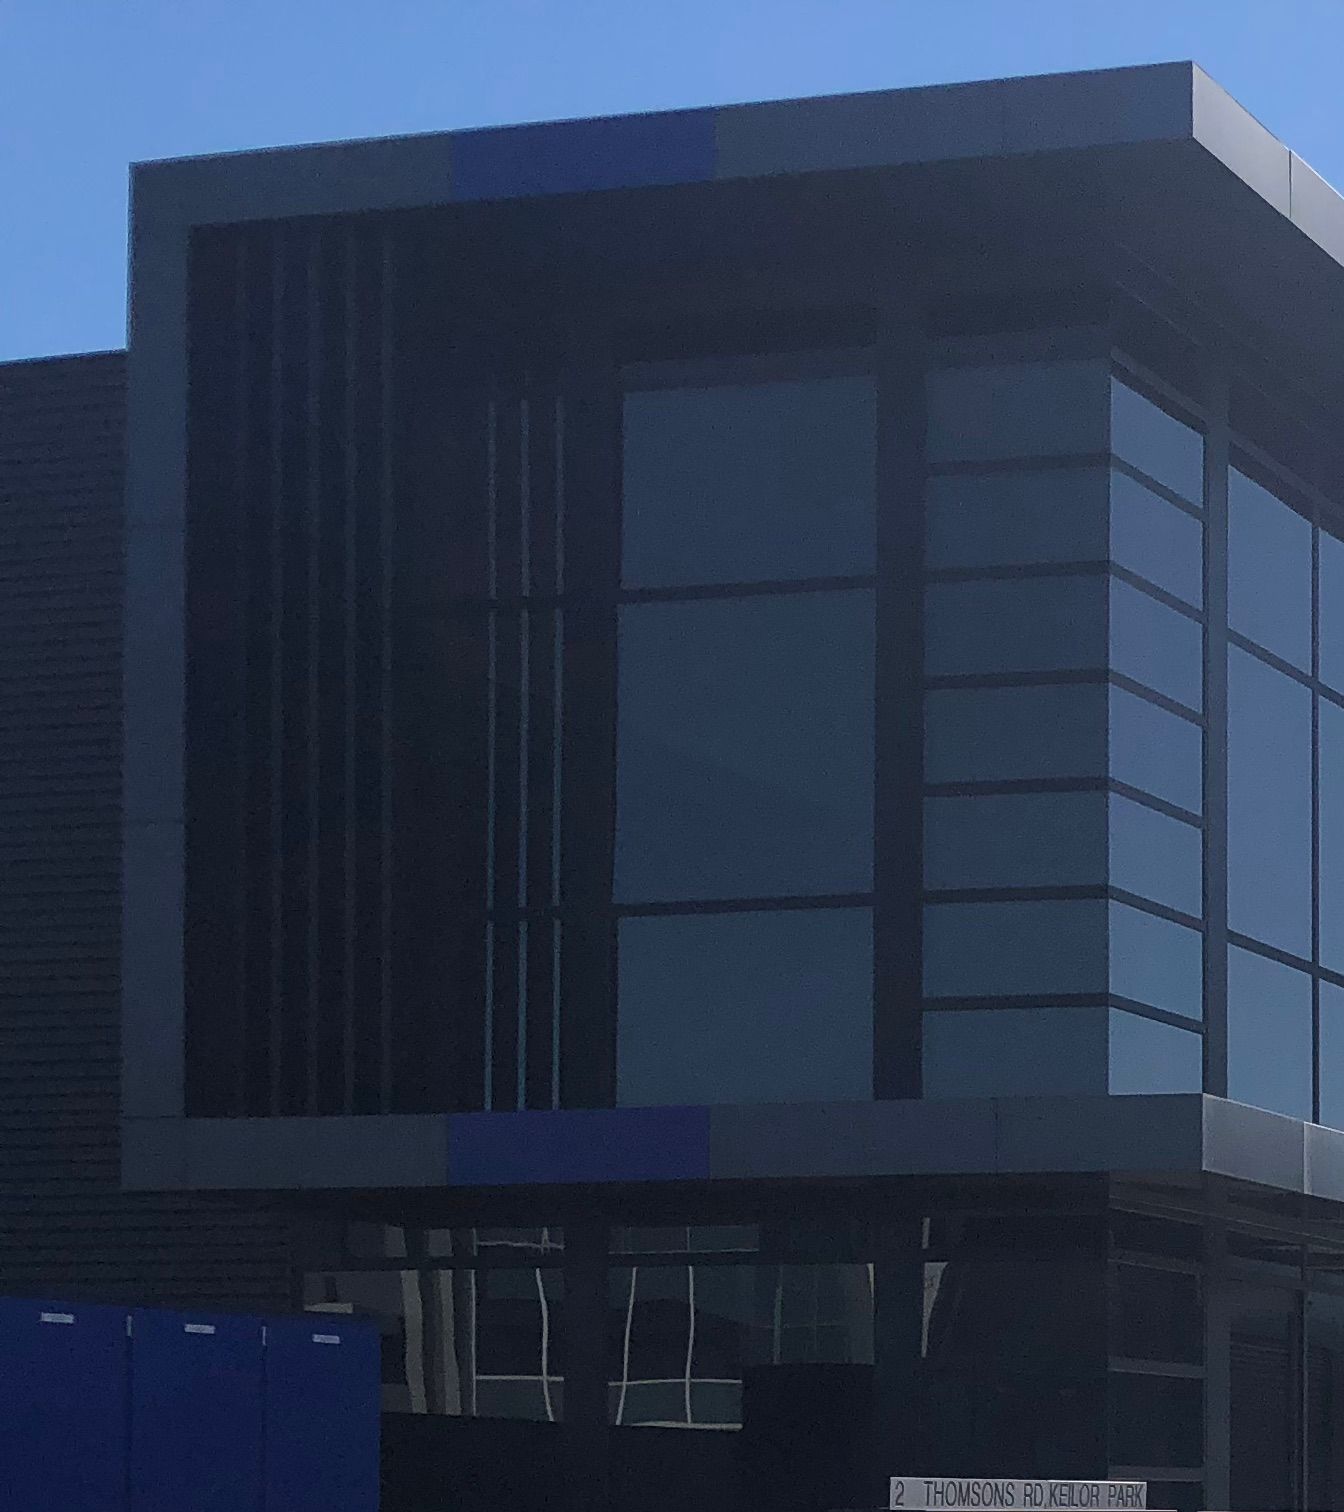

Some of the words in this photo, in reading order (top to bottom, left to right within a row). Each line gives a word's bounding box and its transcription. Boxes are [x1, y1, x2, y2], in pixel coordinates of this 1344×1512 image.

[895, 1481, 905, 1506] 2
[923, 1481, 1015, 1508] THOMSONS
[1107, 1484, 1144, 1508] PARK
